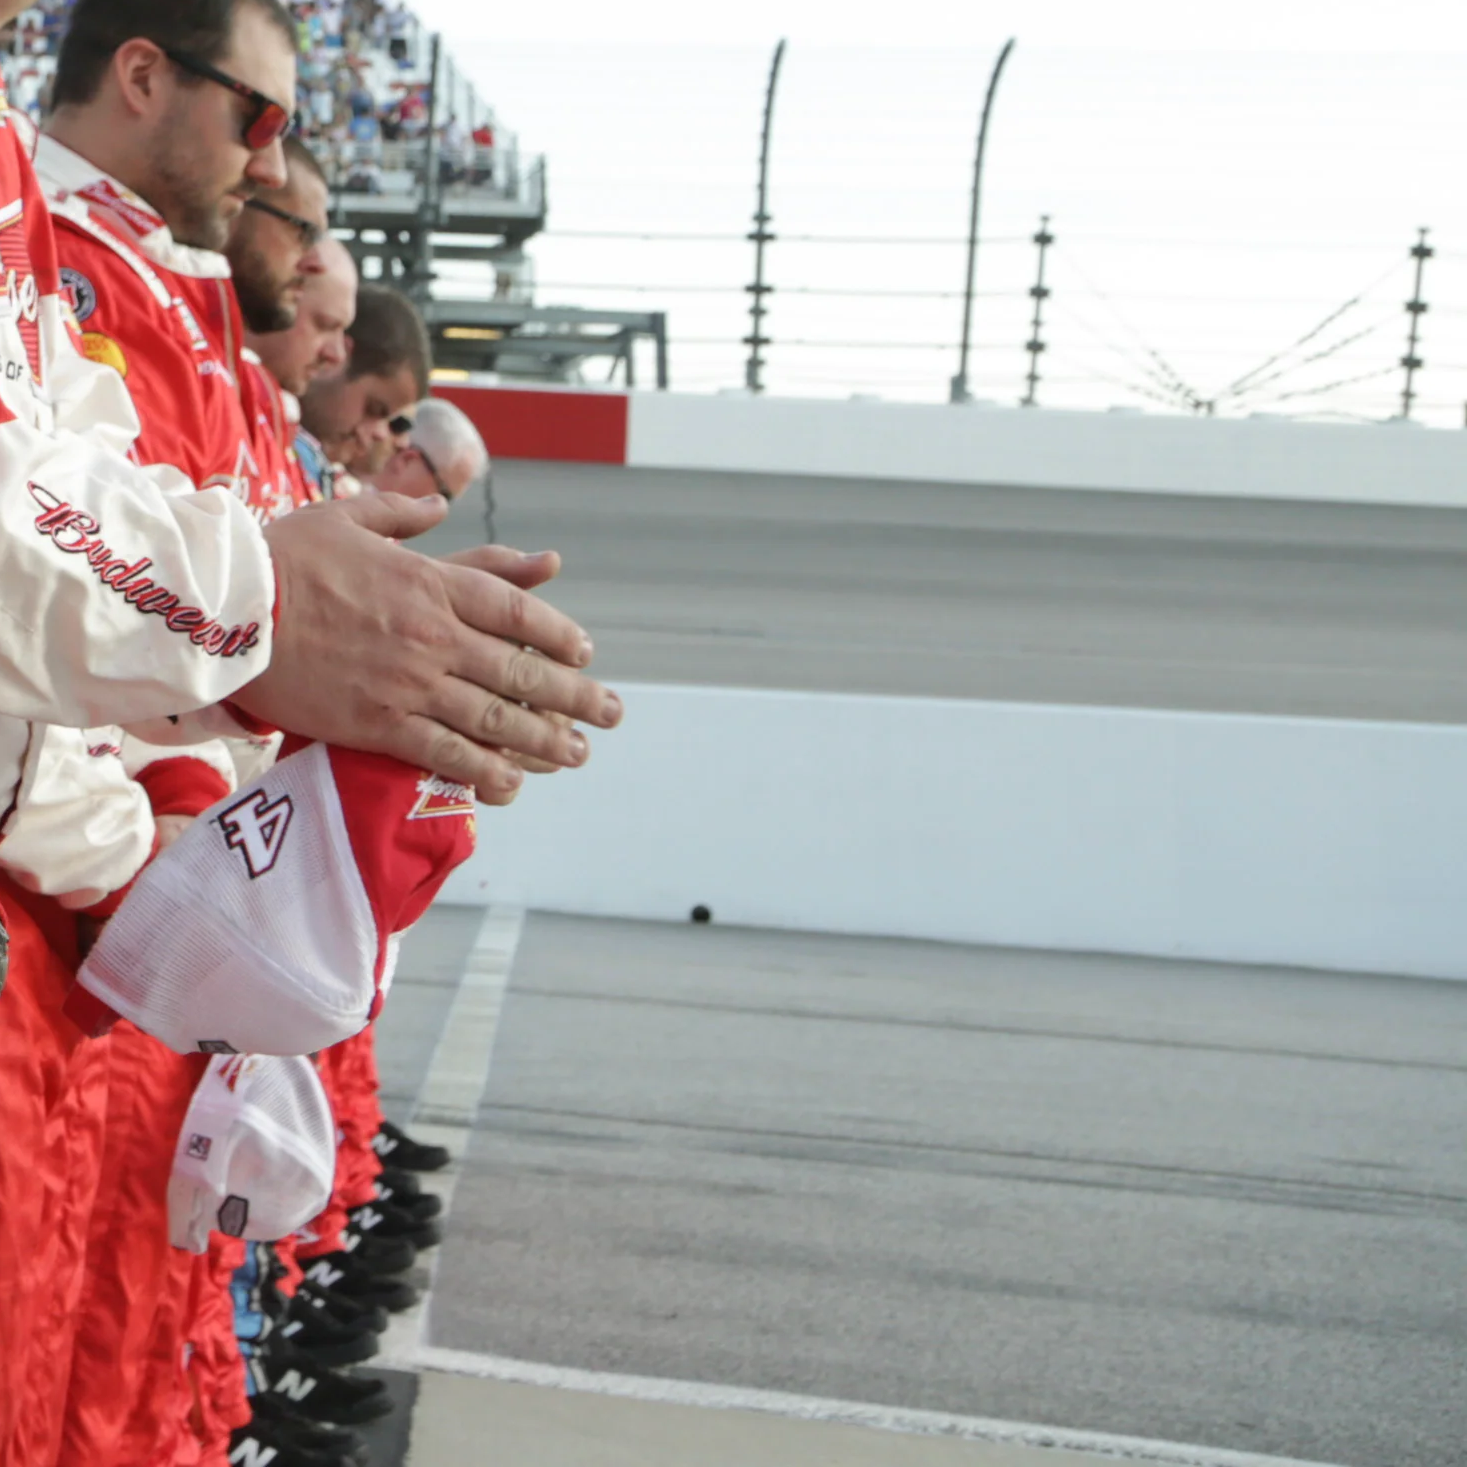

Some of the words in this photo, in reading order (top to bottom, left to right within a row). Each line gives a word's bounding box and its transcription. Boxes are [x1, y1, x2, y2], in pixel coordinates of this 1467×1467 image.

[5, 359, 24, 382] OF
[27, 480, 260, 658] Budweiser
[218, 788, 295, 880] 4
